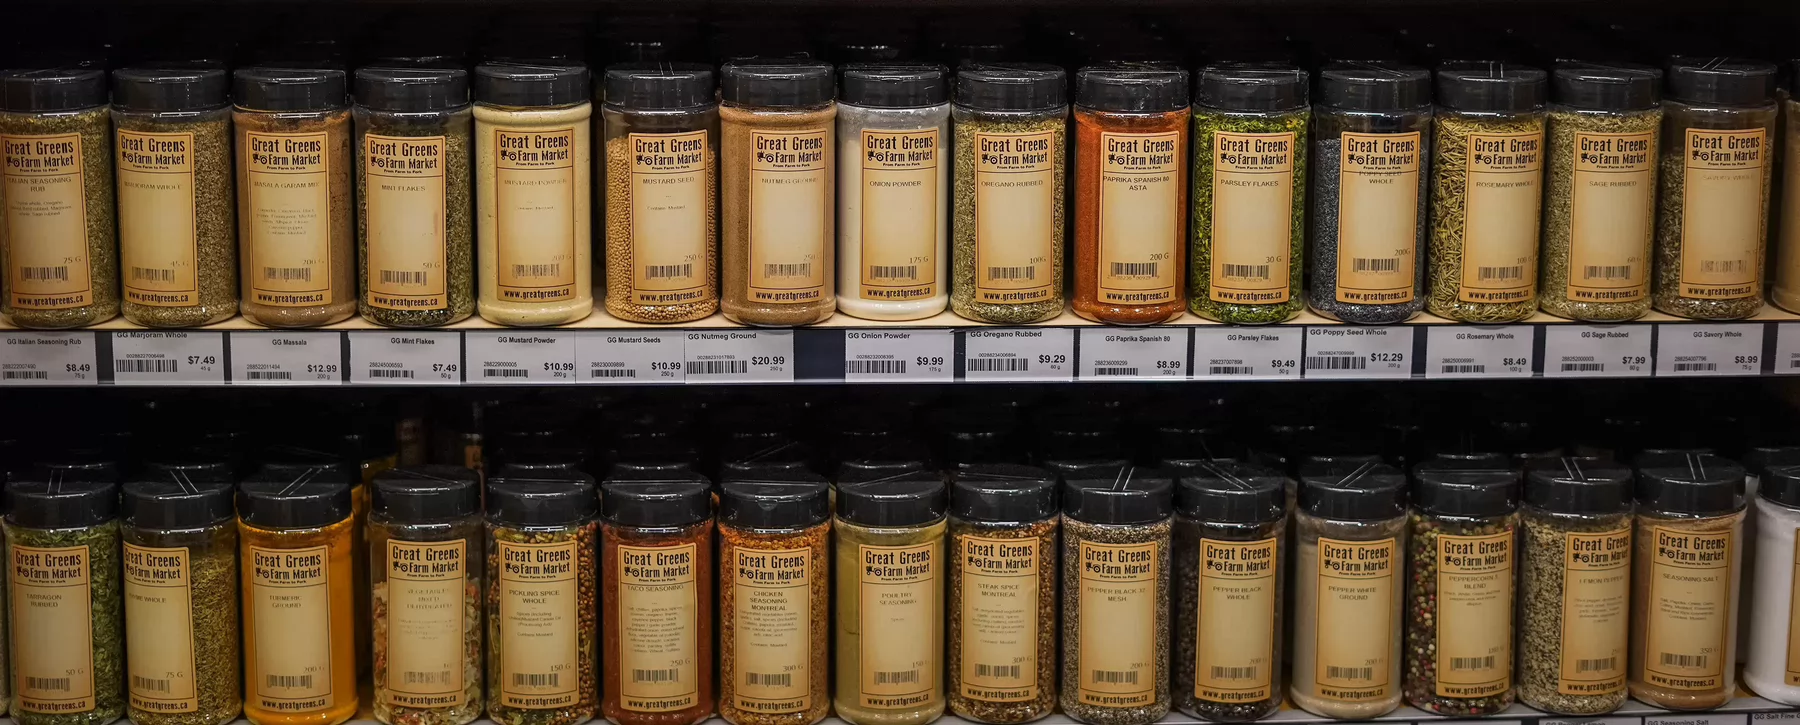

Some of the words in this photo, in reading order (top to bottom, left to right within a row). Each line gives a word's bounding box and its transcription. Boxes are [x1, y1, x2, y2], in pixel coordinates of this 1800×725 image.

[252, 137, 279, 153] Great
[285, 139, 321, 153] Greens
[500, 133, 530, 149] Great
[535, 135, 569, 149] Greens
[1220, 137, 1250, 152] Great
[1255, 139, 1288, 152] Greens
[269, 154, 289, 165] Farm
[292, 154, 321, 165] Market
[518, 150, 538, 162] Farm
[541, 149, 569, 161] Market
[1237, 154, 1258, 165] Farm
[1261, 154, 1287, 165] Market
[1149, 253, 1162, 261] 200
[504, 288, 569, 300] www.greatgreens.ca
[1218, 290, 1282, 302] www.greatgreens.ca
[258, 293, 323, 305] www.greatgreens.ca
[130, 332, 164, 340] Marjoram
[701, 333, 729, 341] Nutmeg
[983, 331, 1013, 339] Oregano
[1323, 329, 1345, 337] Poppy
[1466, 333, 1495, 341] Rosemary
[1116, 335, 1137, 343] Paprika
[1139, 335, 1162, 343] Spanish
[188, 356, 216, 365] $7.49
[751, 357, 785, 365] $20.99
[916, 357, 944, 366] $9.99
[1038, 355, 1066, 364] $9.29
[1370, 353, 1403, 362] $12.29
[1503, 357, 1527, 366] $8.49
[1734, 356, 1758, 364] $8.99
[66, 364, 91, 372] $8.49
[307, 365, 337, 373] $12.99
[432, 364, 457, 373] $7.49
[543, 362, 574, 371] $10.99
[651, 362, 681, 371] $10.99
[1156, 361, 1181, 369] $8.99
[1271, 360, 1295, 369] $9.49
[1324, 544, 1352, 559] Great
[1358, 546, 1389, 559] Greens
[255, 552, 280, 568] Great
[286, 554, 321, 568] Greens
[739, 552, 766, 568] Great
[771, 555, 805, 569] Greens
[1341, 561, 1361, 572] Farm
[1364, 559, 1388, 571] Market
[270, 568, 290, 580] Farm
[293, 568, 321, 579] Market
[755, 569, 774, 581] Farm
[777, 568, 804, 580] Market
[550, 664, 564, 672] 150
[1321, 689, 1384, 699] www.greatgreens.ca
[262, 699, 325, 710] www.greatgreens.ca
[741, 699, 803, 711] www.greatgreens.ca
